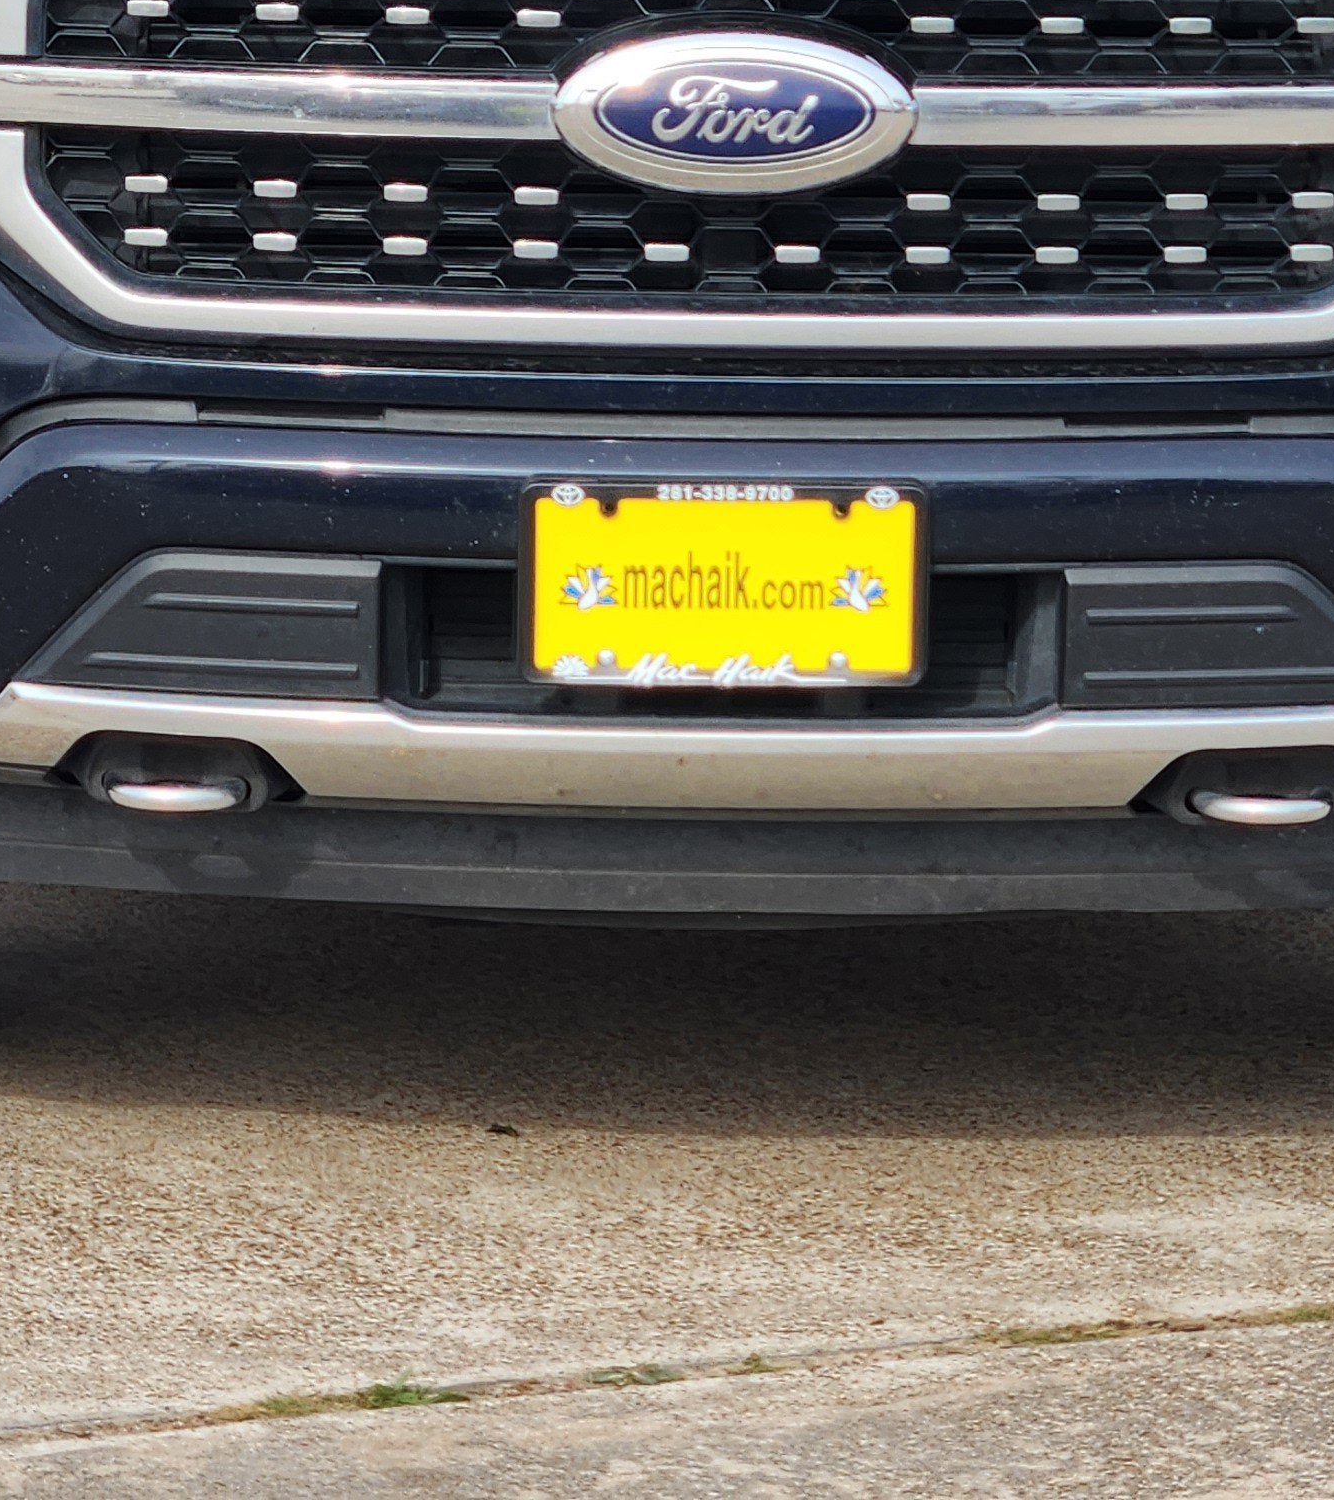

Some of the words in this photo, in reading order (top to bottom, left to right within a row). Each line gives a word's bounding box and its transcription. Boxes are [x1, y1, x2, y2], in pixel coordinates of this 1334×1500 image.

[650, 74, 819, 145] Ford
[623, 550, 825, 609] machaik.com
[630, 652, 697, 688] Mac
[712, 652, 794, 689] Haik
